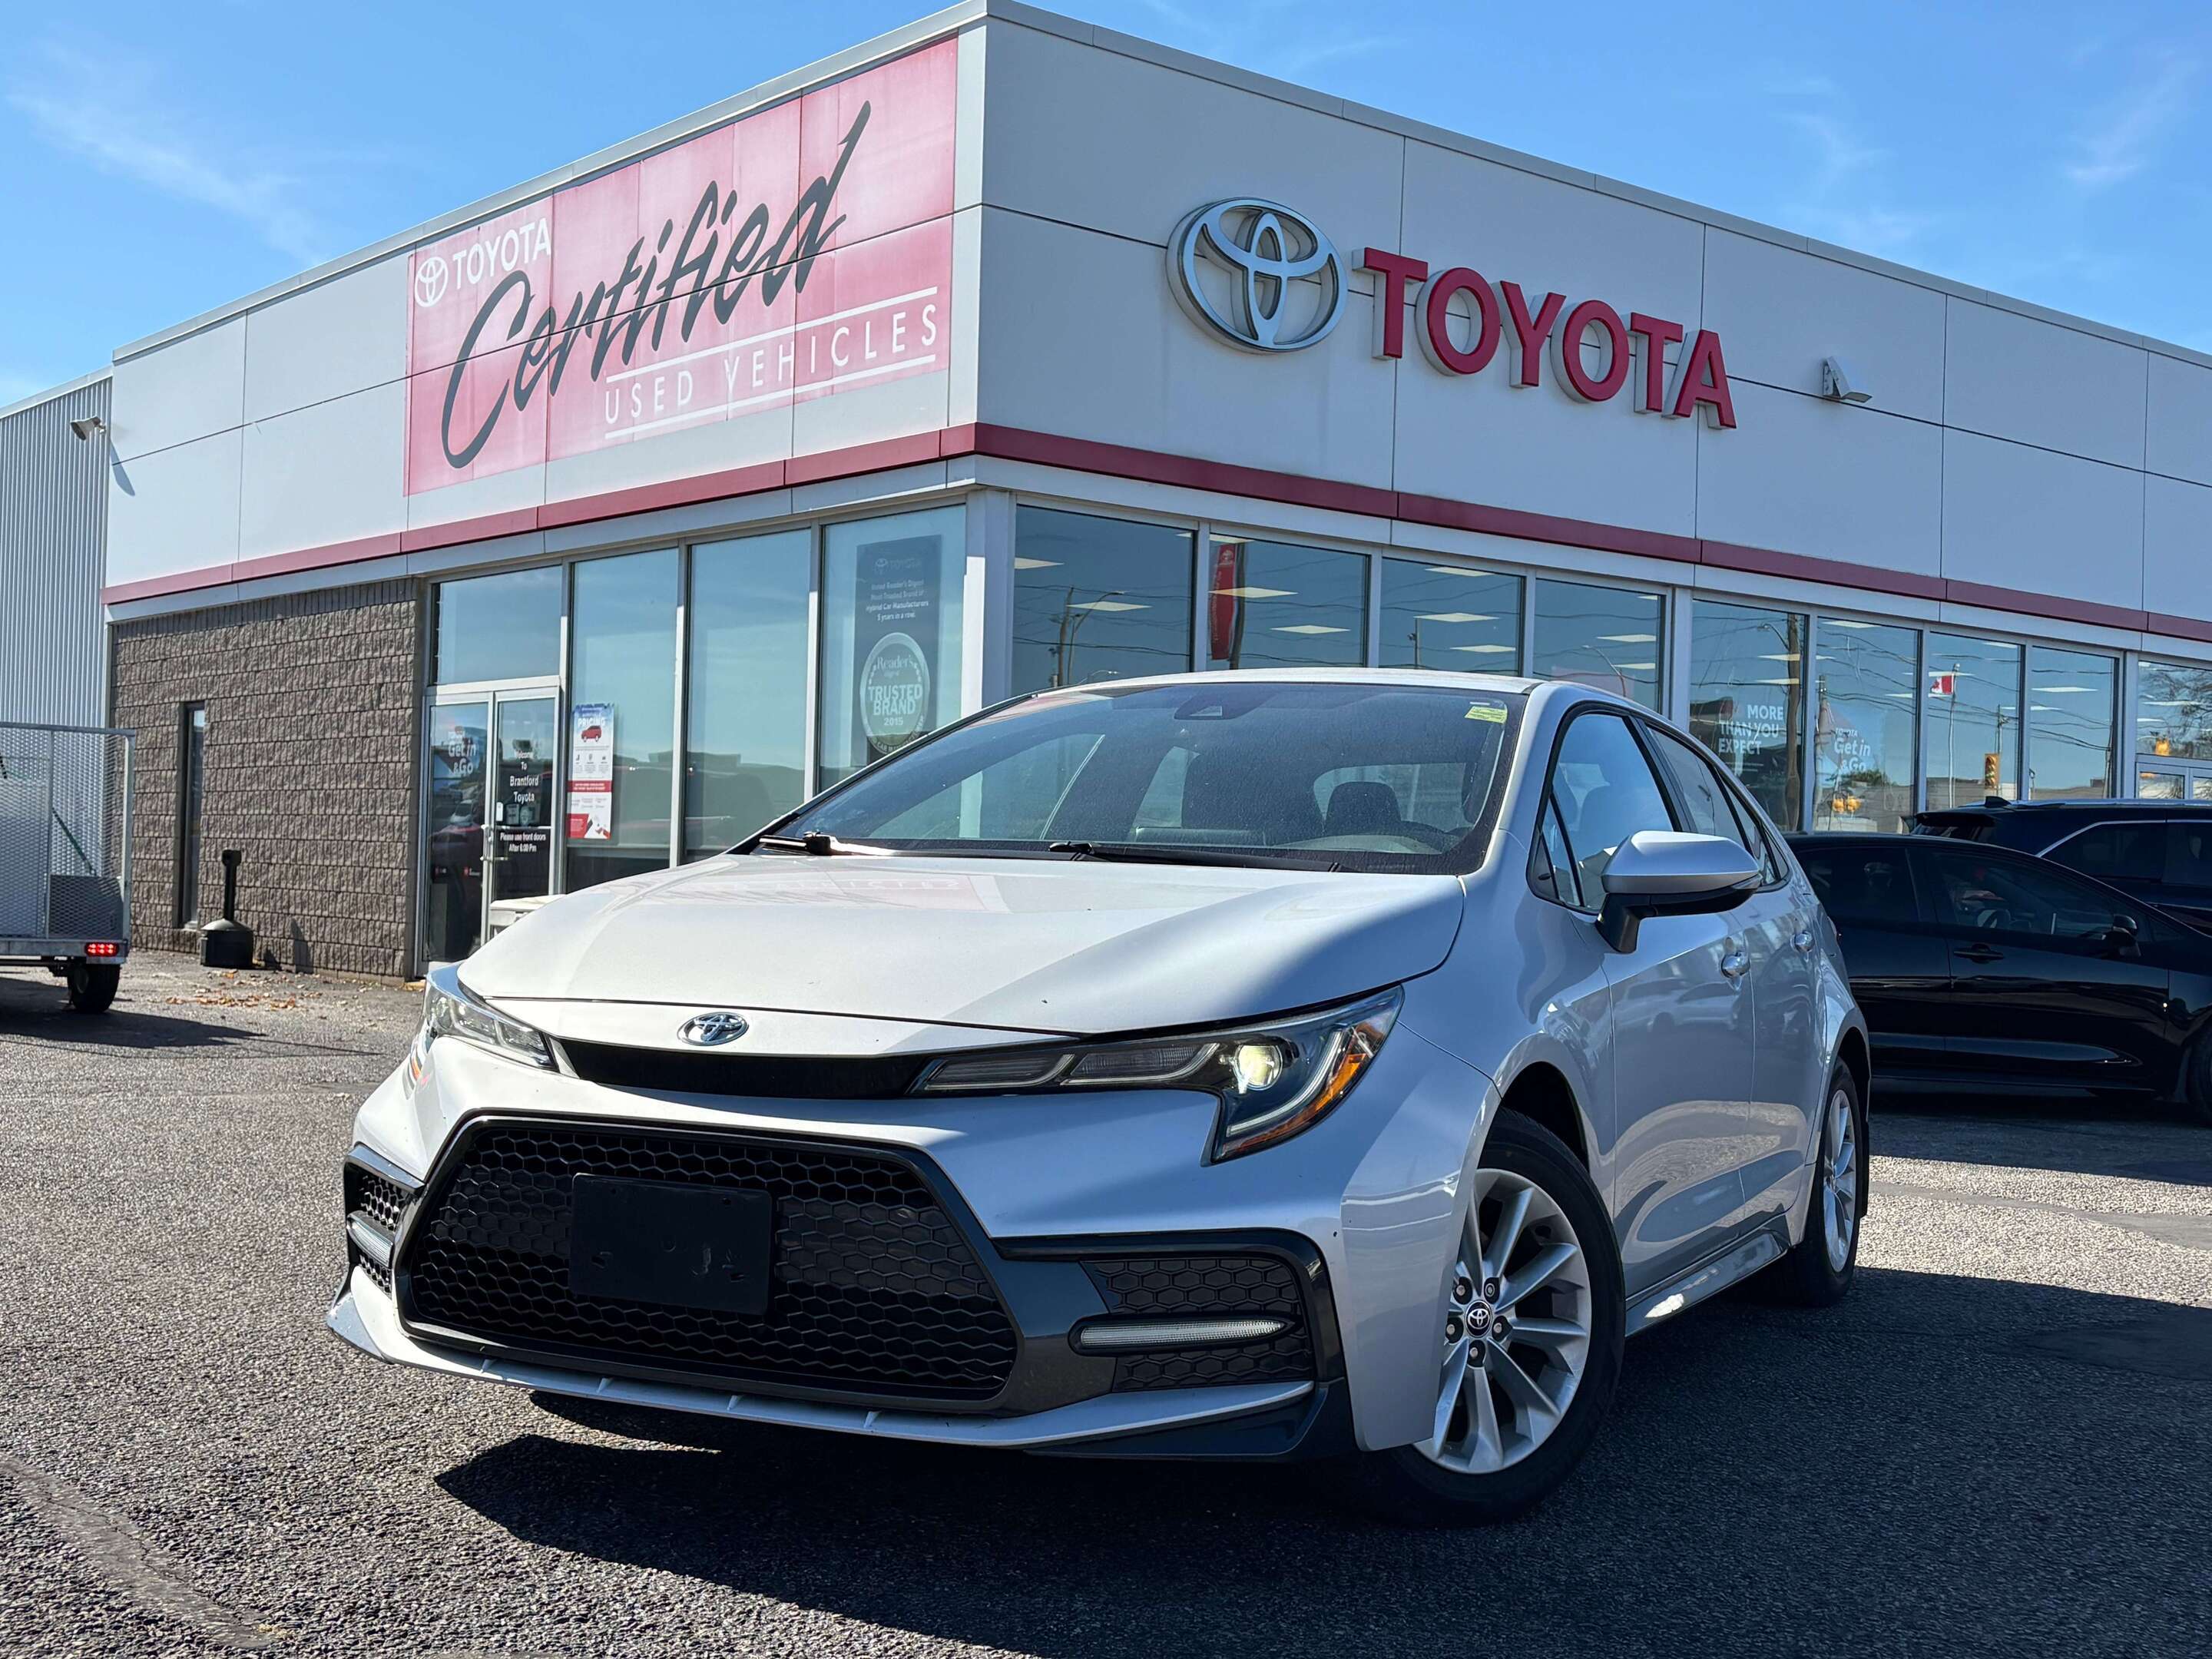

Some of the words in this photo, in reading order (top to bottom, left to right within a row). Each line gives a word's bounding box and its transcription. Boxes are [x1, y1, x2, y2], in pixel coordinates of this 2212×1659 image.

[452, 217, 552, 290] TOYOTA
[441, 101, 871, 469] Certified
[1352, 247, 1737, 430] TOYOTA
[604, 372, 693, 425] USED
[724, 304, 939, 391] VEHICLES
[876, 654, 915, 670] Reader's
[868, 684, 922, 701] TRUSTED
[873, 698, 916, 716] BRAND
[1747, 704, 1784, 720] MORE
[883, 717, 904, 727] 2015
[1718, 720, 1752, 737] THAN
[1752, 722, 1779, 738] YOU
[448, 740, 466, 757] Get
[466, 738, 477, 757] in
[1718, 737, 1762, 755] EXPECT
[1834, 737, 1858, 755] Get
[1859, 738, 1871, 757] in
[459, 757, 474, 776] Go
[521, 761, 528, 771] To
[1848, 757, 1867, 773] Go
[509, 775, 539, 787] Brantford
[513, 791, 535, 805] Toyota
[499, 832, 514, 841] Please
[522, 832, 533, 842] front
[533, 832, 547, 842] doors
